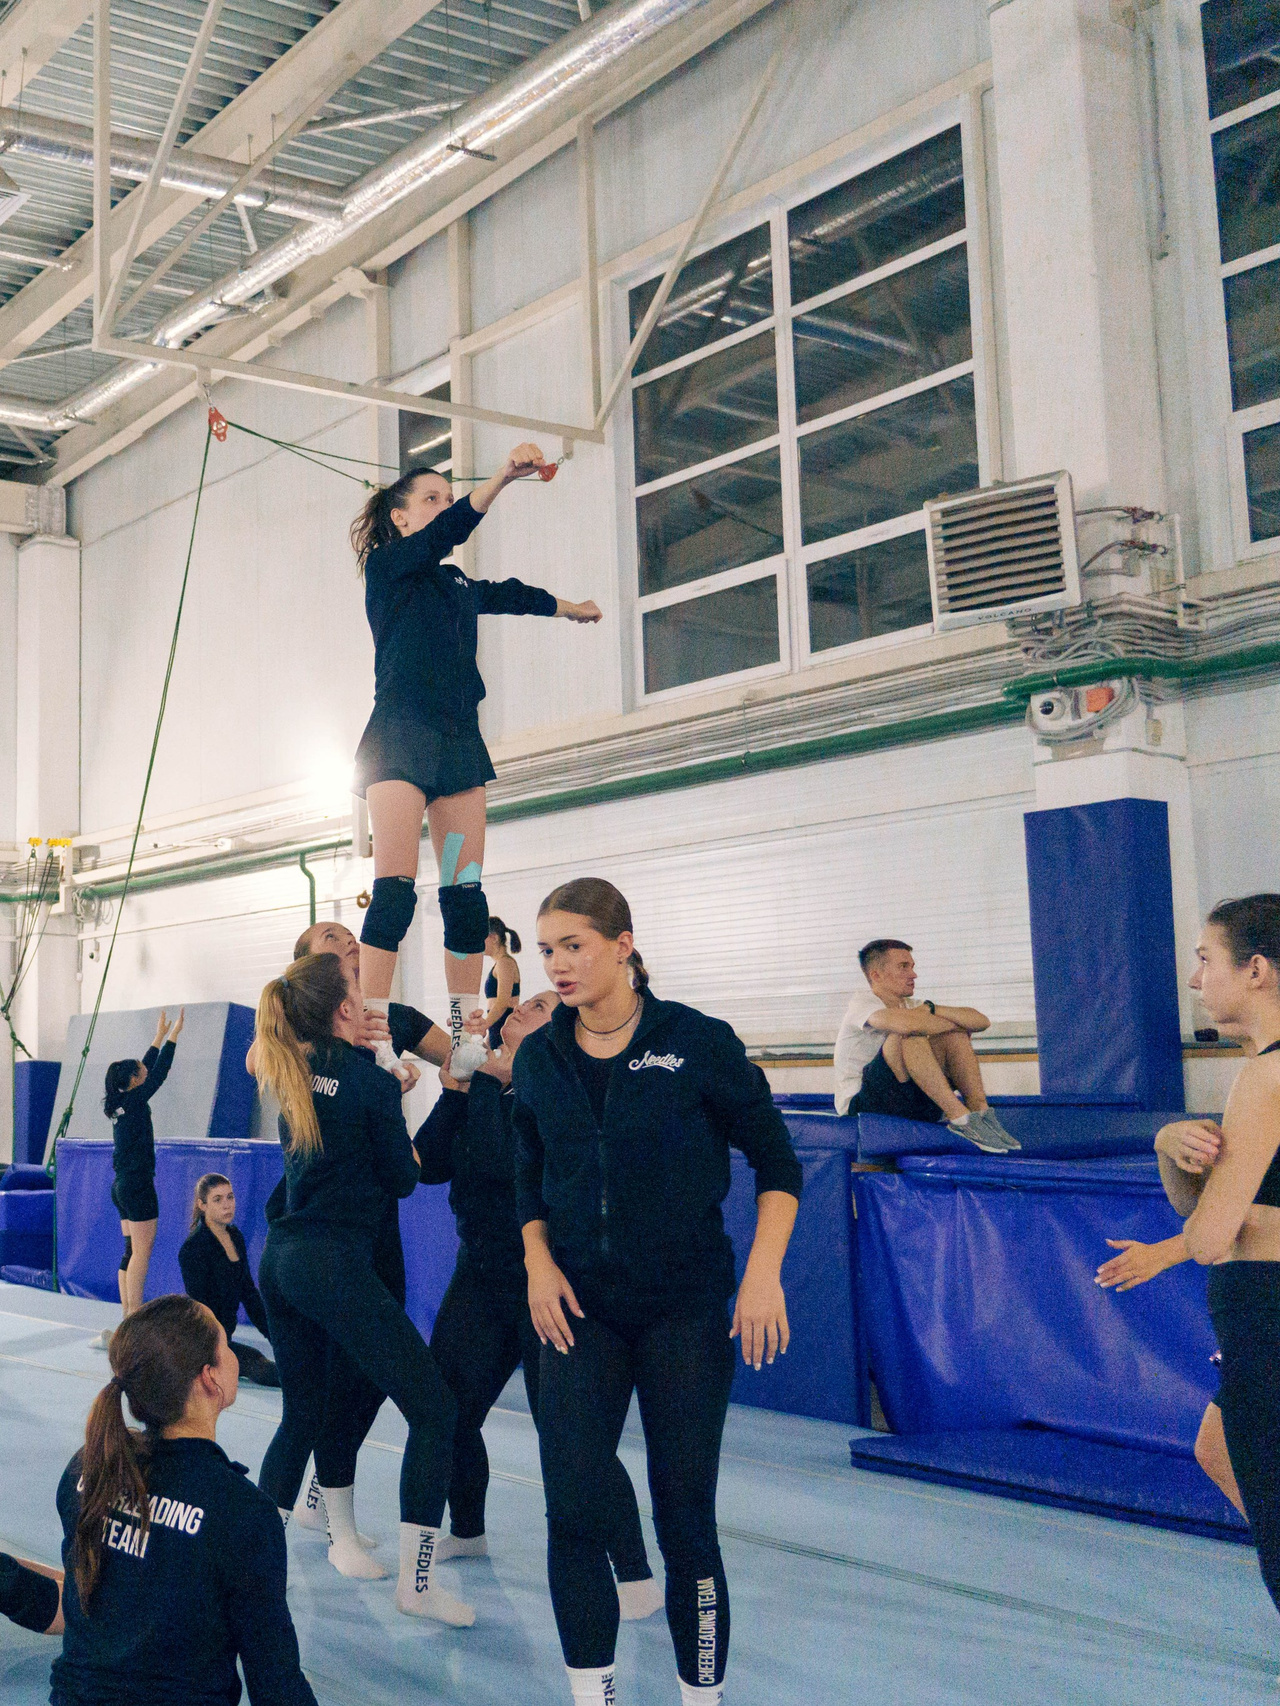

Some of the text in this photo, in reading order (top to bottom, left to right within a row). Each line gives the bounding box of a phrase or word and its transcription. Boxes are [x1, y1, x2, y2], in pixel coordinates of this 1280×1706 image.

[978, 608, 1032, 620] VOLCANO
[450, 1000, 464, 1051] NEEDLES
[628, 1050, 685, 1073] Needles
[415, 1534, 435, 1594] NEEDLES
[696, 1576, 716, 1685] CHEERLEADING TEAM
